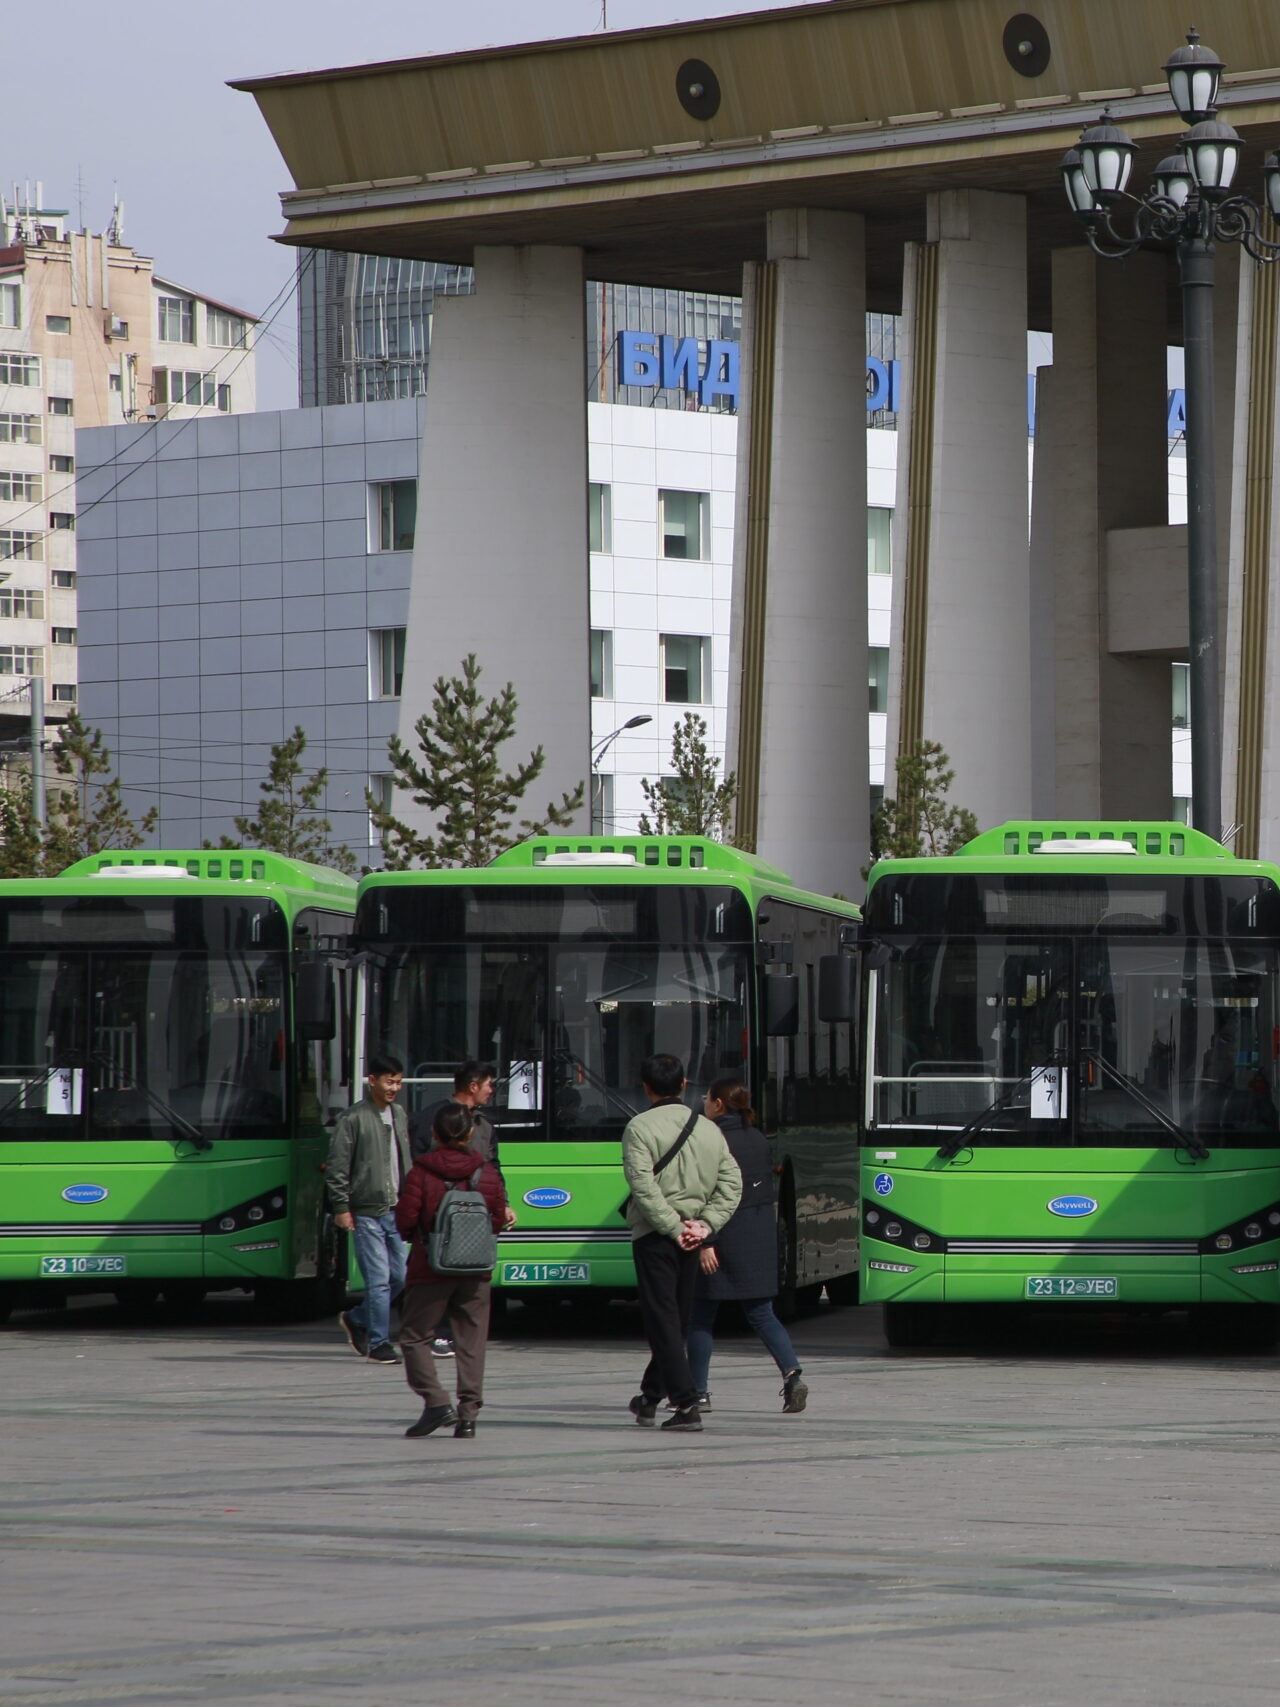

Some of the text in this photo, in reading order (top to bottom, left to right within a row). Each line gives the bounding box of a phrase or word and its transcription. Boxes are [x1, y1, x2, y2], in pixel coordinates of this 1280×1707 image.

[1043, 1073, 1057, 1084] №
[61, 1088, 69, 1100] 5
[522, 1082, 530, 1094] 6
[1045, 1090, 1054, 1102] 7
[1053, 1201, 1092, 1210] Skywell
